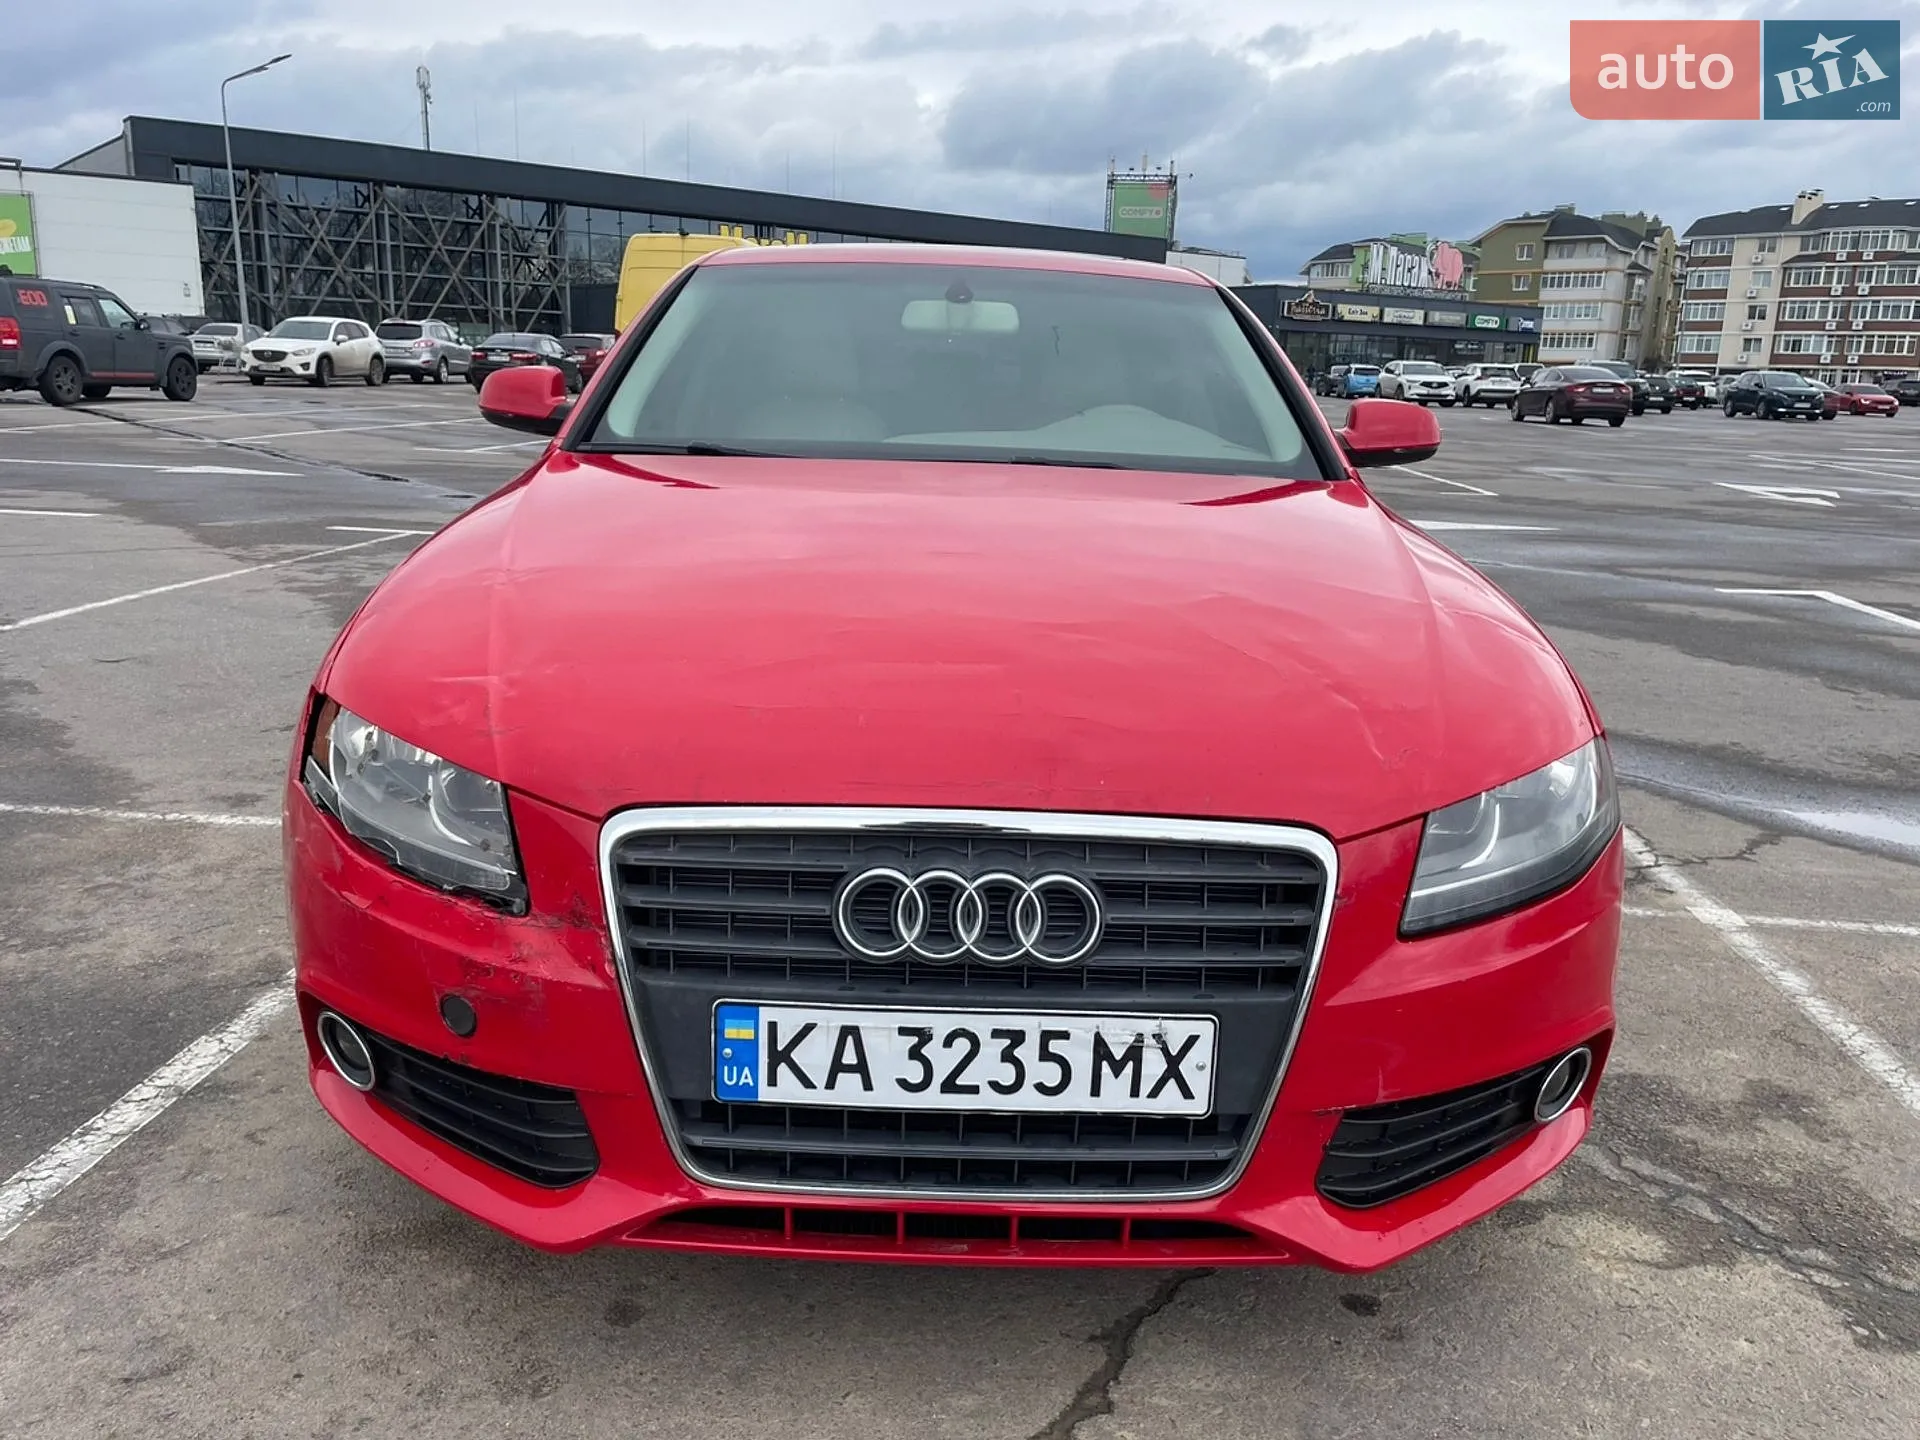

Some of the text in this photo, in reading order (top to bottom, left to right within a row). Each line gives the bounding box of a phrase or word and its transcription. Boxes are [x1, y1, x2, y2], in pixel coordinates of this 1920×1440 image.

[1120, 208, 1154, 217] COMFY
[1476, 316, 1495, 327] COMFY
[766, 1021, 1201, 1100] KA 3235 MX
[723, 1064, 754, 1087] UA
